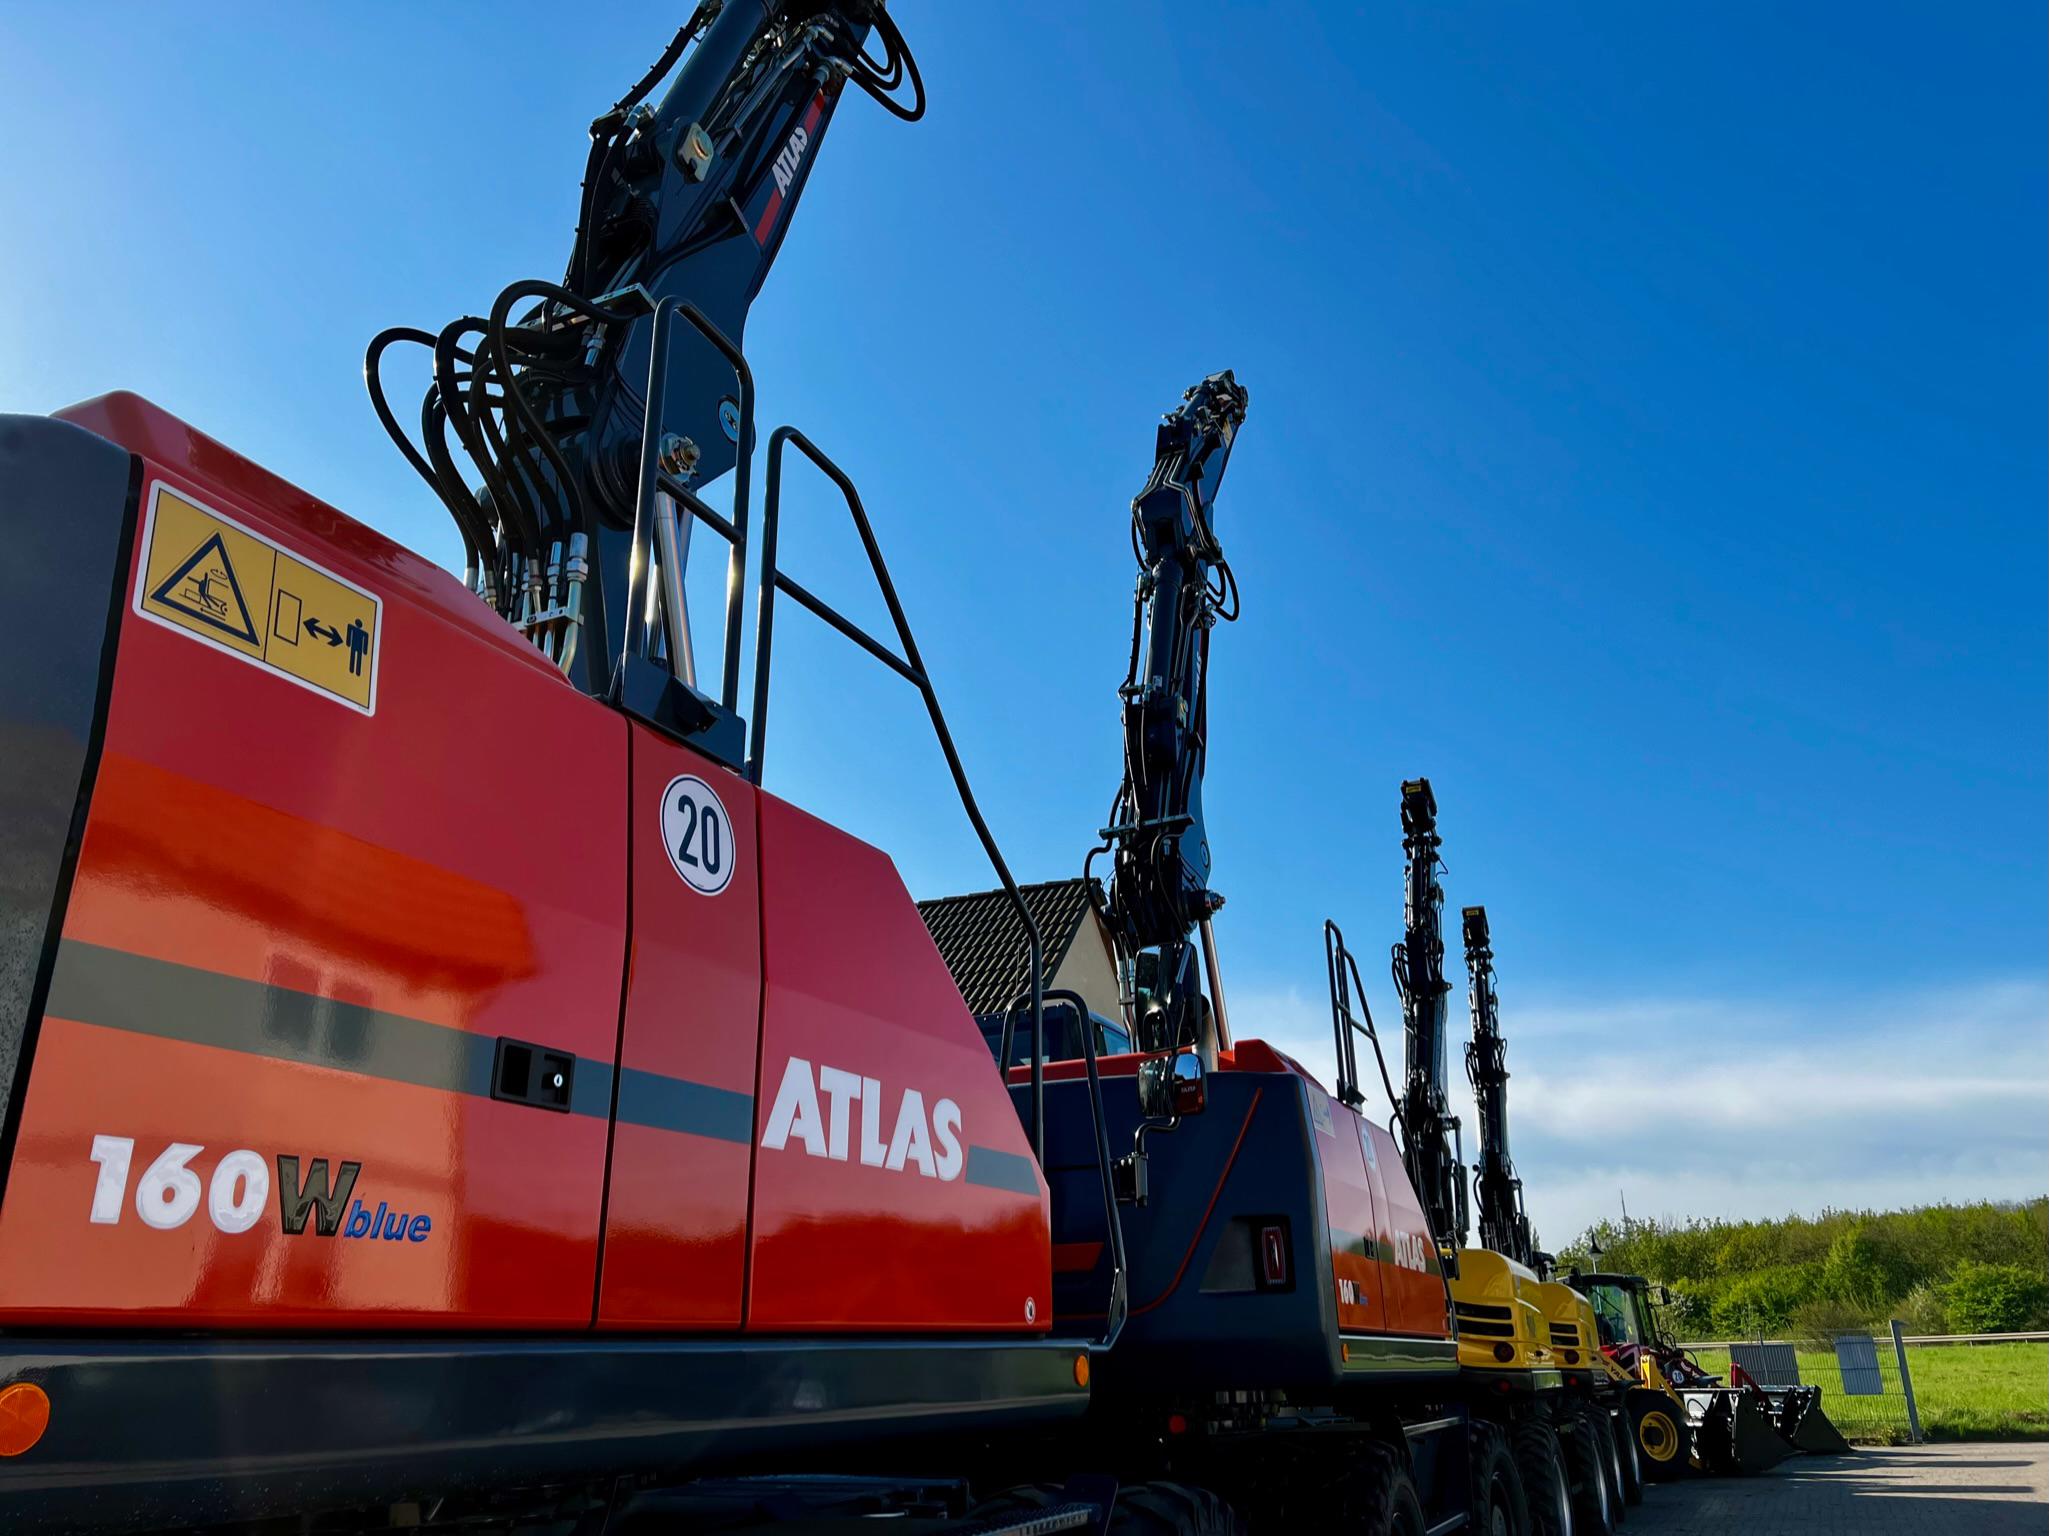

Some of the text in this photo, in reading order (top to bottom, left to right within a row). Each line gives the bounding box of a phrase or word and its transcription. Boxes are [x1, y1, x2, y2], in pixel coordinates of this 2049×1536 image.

[771, 126, 808, 199] ATLAS
[678, 794, 721, 875] 20
[760, 1055, 963, 1182] ATLAS
[1394, 1229, 1426, 1273] ATLAS
